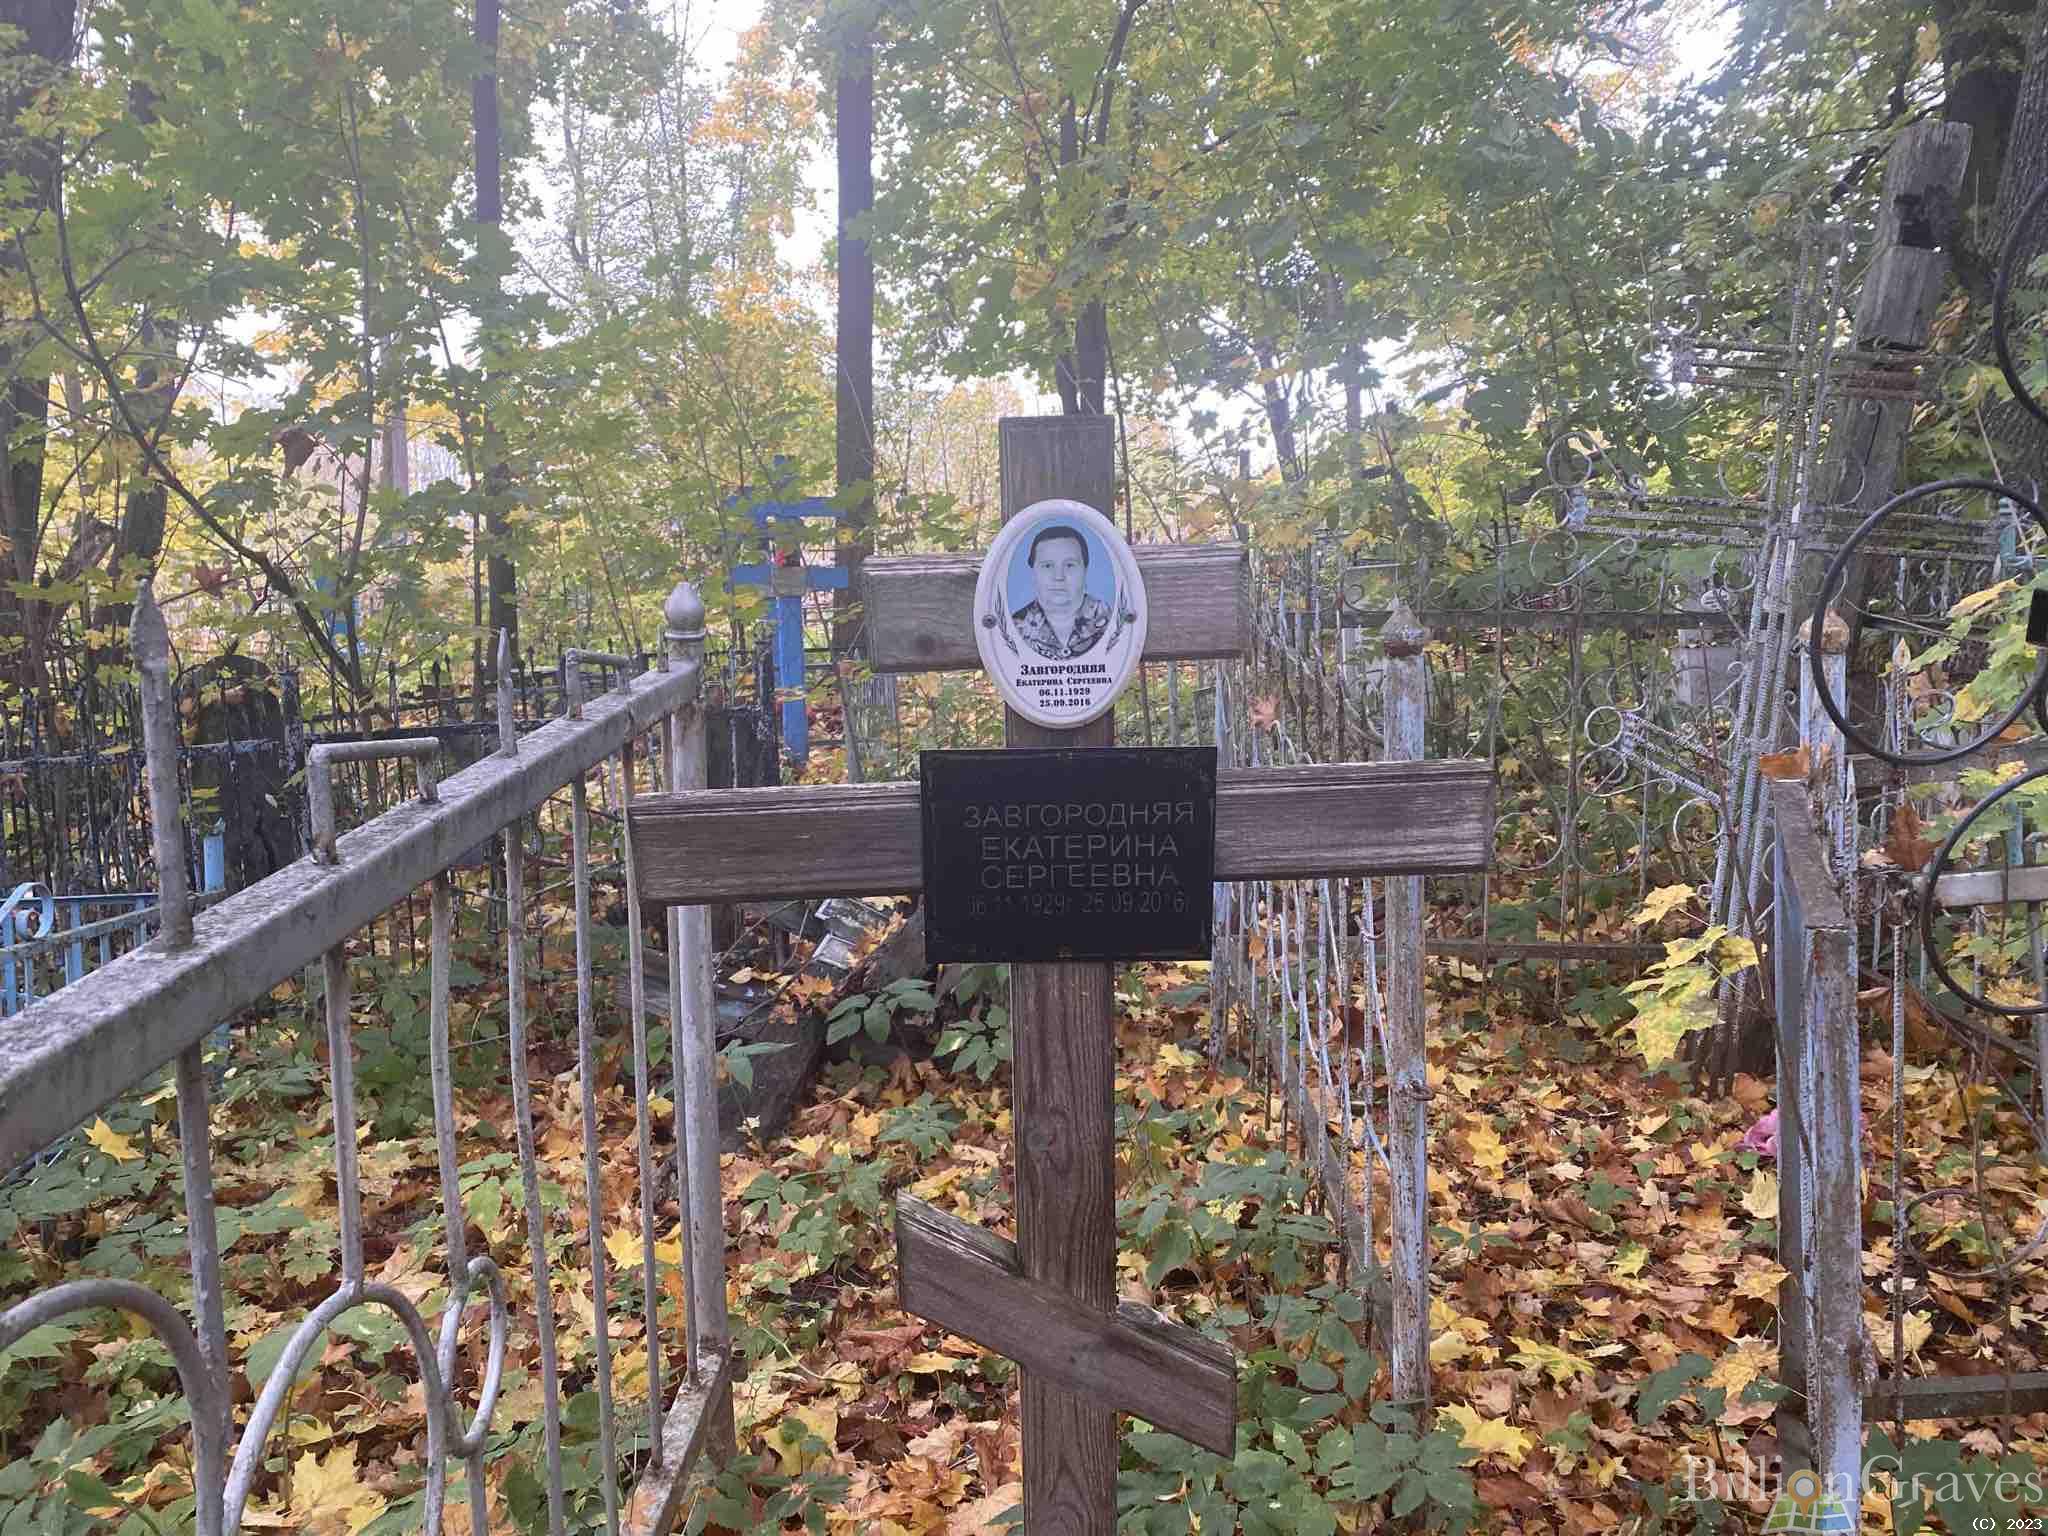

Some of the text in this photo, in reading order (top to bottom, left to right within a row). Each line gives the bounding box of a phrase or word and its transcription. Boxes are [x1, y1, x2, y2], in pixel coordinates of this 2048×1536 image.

[1039, 688, 1090, 697] 06.11.1929
[1039, 699, 1091, 708] 25.09.2016
[964, 801, 1194, 832] ЗАВГОРОДНЯЯ
[980, 833, 1179, 860] ЕКАТЕРИНА
[980, 863, 1179, 889] СЕРГЕЕВНА
